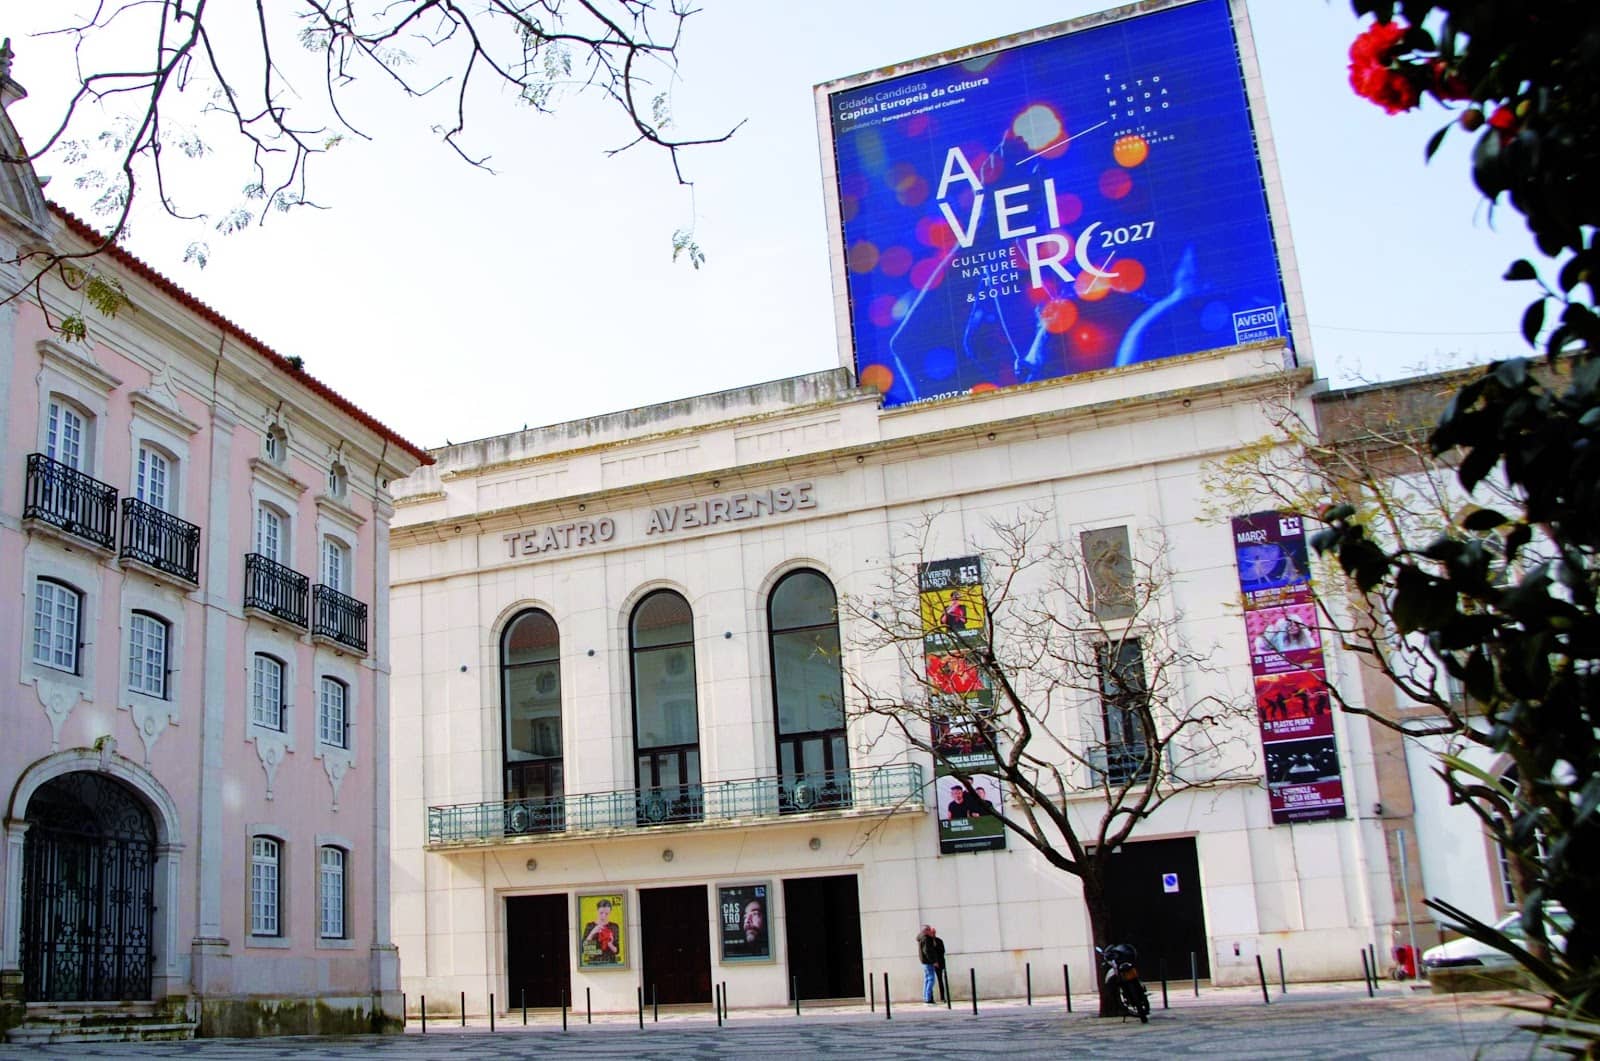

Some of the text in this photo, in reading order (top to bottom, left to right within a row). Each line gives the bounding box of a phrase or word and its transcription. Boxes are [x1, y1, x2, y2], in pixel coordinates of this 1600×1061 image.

[839, 82, 927, 111] Cidade Candidata
[840, 77, 989, 120] Capital Europeia da Cultura
[1100, 221, 1156, 248] 2027
[952, 247, 1017, 268] CULTURE
[962, 260, 1018, 279] NATURE
[982, 272, 1019, 287] TECH
[503, 482, 817, 557] TEATRO AVEIRENSE
[723, 903, 740, 913] CAS
[723, 913, 740, 923] TRO
